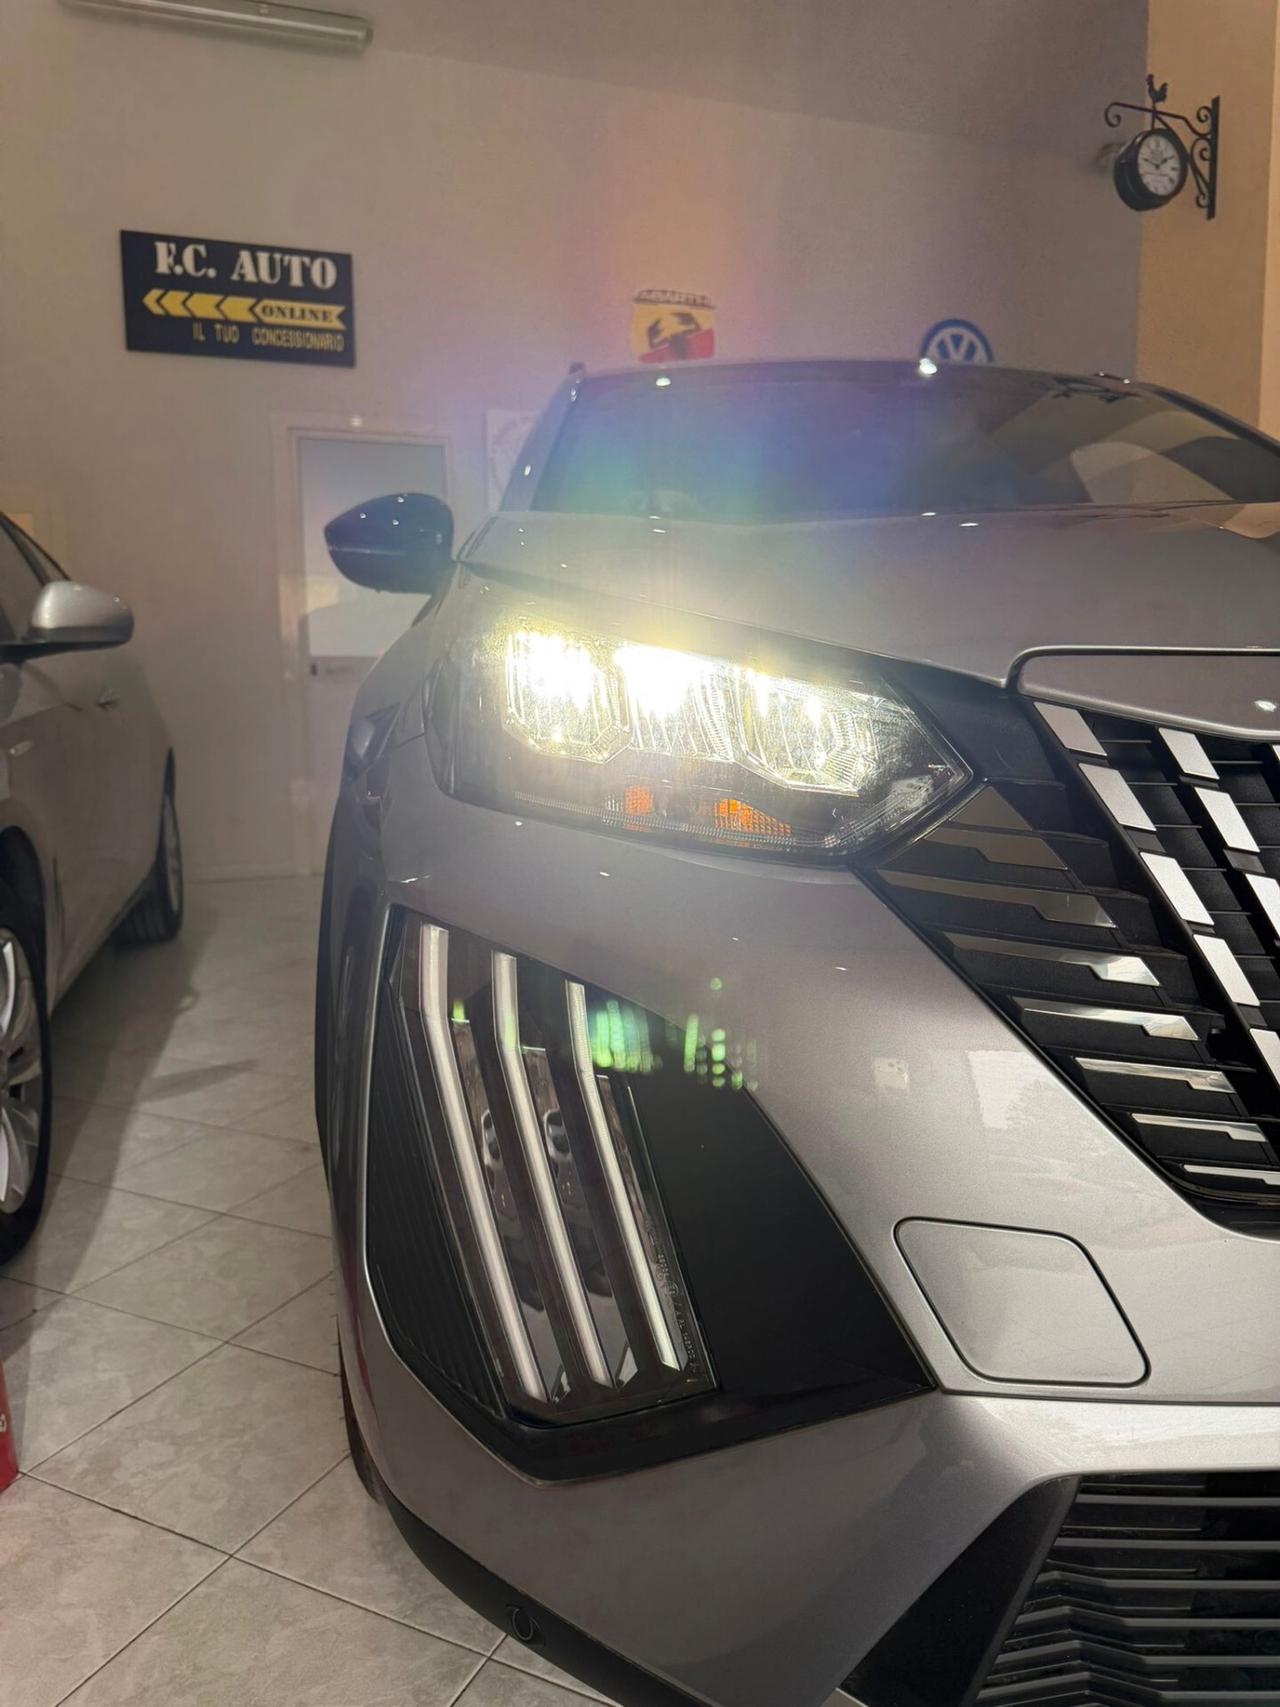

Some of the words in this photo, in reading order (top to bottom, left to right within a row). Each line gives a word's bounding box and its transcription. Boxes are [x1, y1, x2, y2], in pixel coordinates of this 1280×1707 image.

[154, 241, 217, 278] F.C.
[230, 249, 338, 290] AUTO
[261, 304, 334, 323] ONLINE
[192, 323, 206, 342] IL
[213, 323, 240, 344] TUO
[252, 327, 344, 352] CONCESSIONARIO
